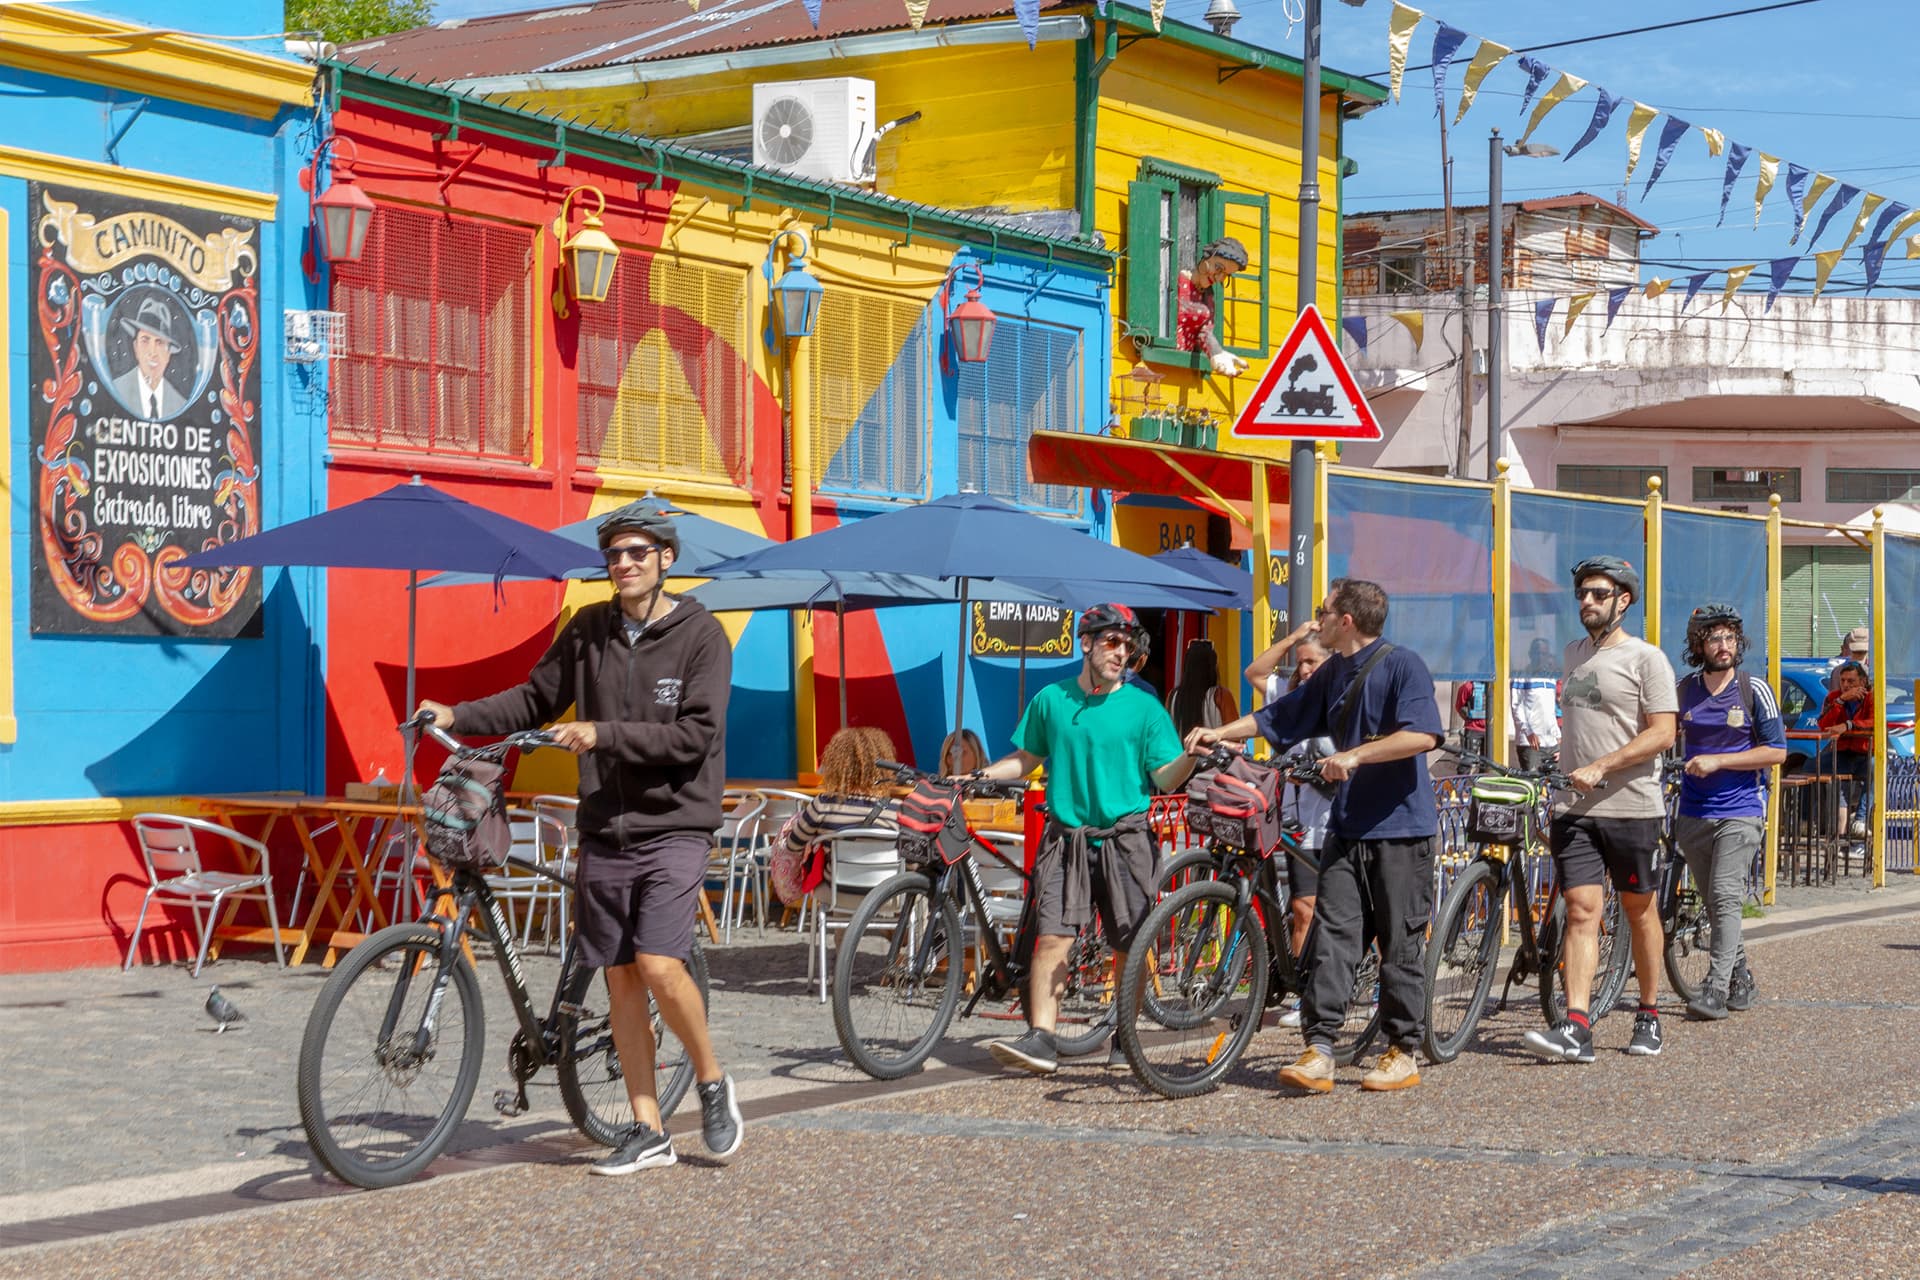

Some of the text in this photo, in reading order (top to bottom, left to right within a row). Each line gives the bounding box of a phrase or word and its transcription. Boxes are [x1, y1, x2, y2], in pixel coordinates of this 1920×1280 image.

[95, 219, 205, 274] CAMINITO
[95, 417, 212, 452] CENTRO DE
[94, 448, 212, 490] EXPOSICIONES
[93, 485, 212, 529] Entrada libre
[1160, 522, 1196, 550] BAR
